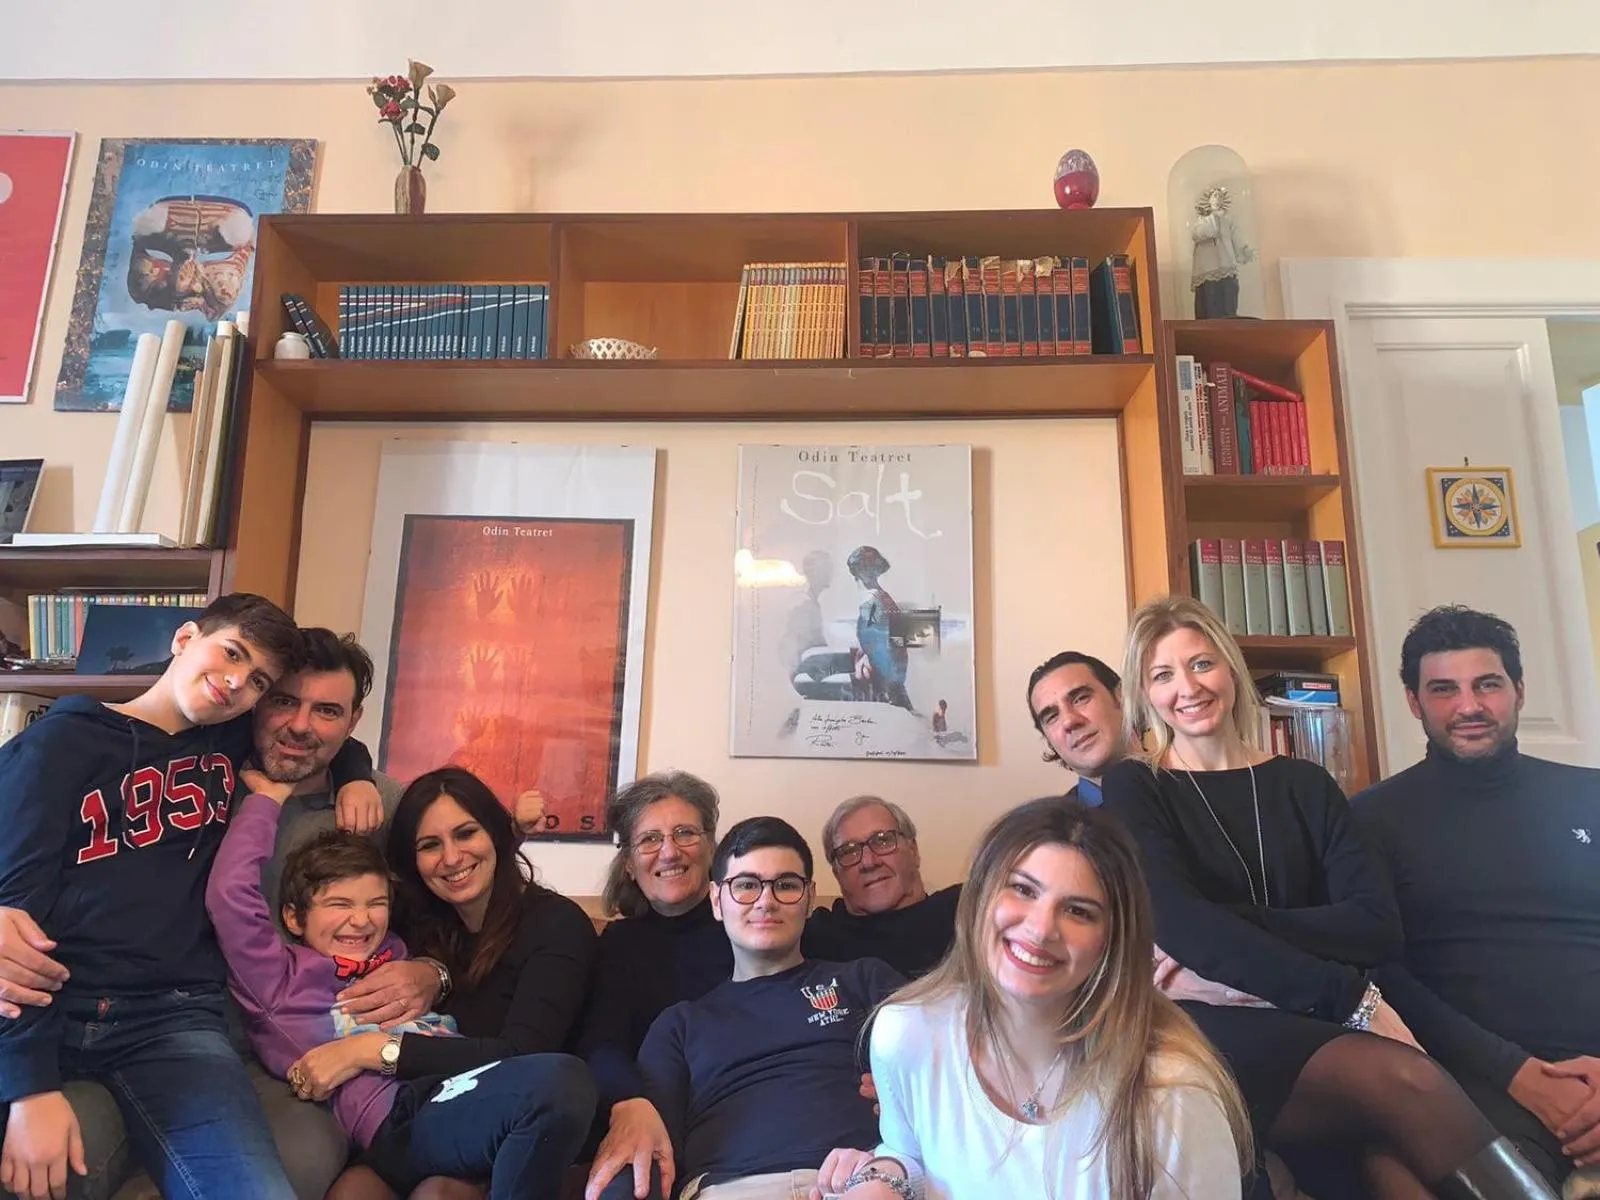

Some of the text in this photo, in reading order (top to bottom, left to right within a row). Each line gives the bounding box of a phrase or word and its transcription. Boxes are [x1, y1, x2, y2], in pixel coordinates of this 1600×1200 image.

[136, 158, 277, 173] ODIN TEATRET
[798, 450, 913, 463] Odin Teatret
[780, 464, 944, 539] Salt
[482, 525, 554, 538] Odin Teatret
[77, 752, 235, 864] 1953
